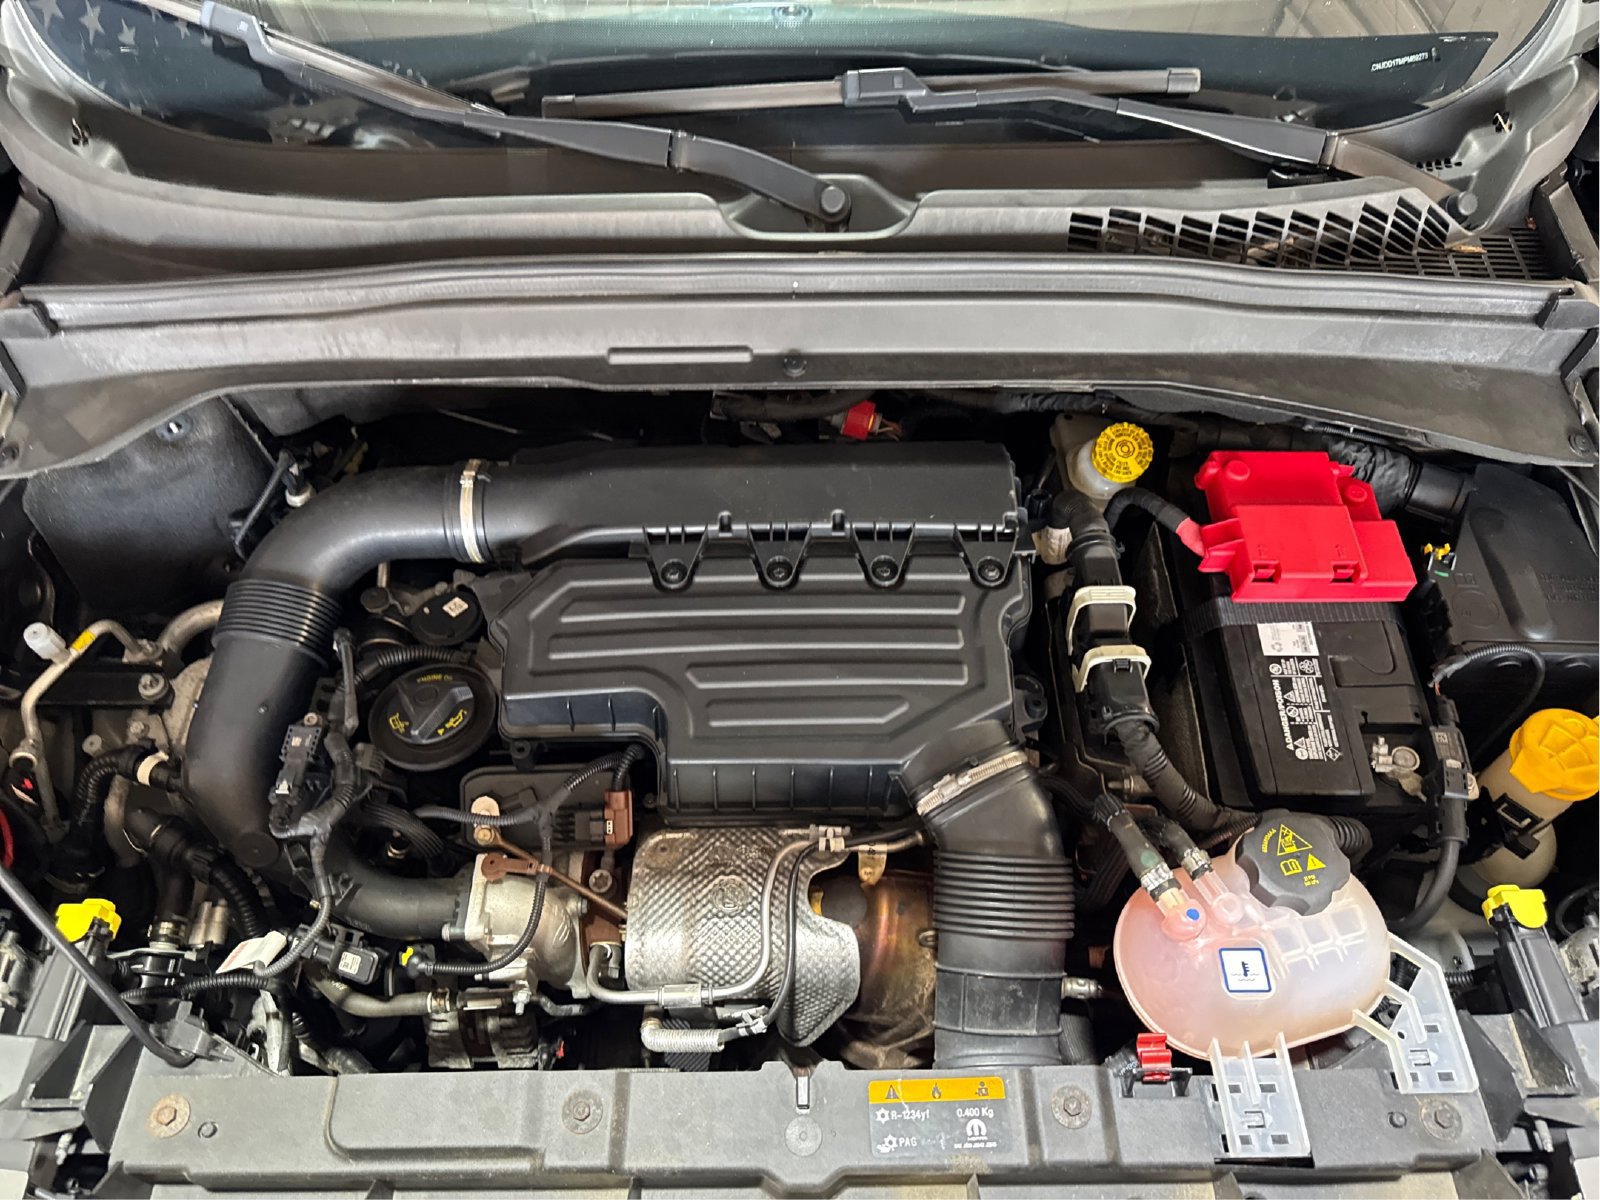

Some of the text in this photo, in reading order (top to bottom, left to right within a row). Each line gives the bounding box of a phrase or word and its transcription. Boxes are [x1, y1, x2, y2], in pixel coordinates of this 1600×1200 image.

[1272, 679, 1292, 743] DANGER/POISON
[956, 1108, 980, 1118] 0.400
[981, 1107, 994, 1119] Kg
[899, 1137, 918, 1147] PAG
